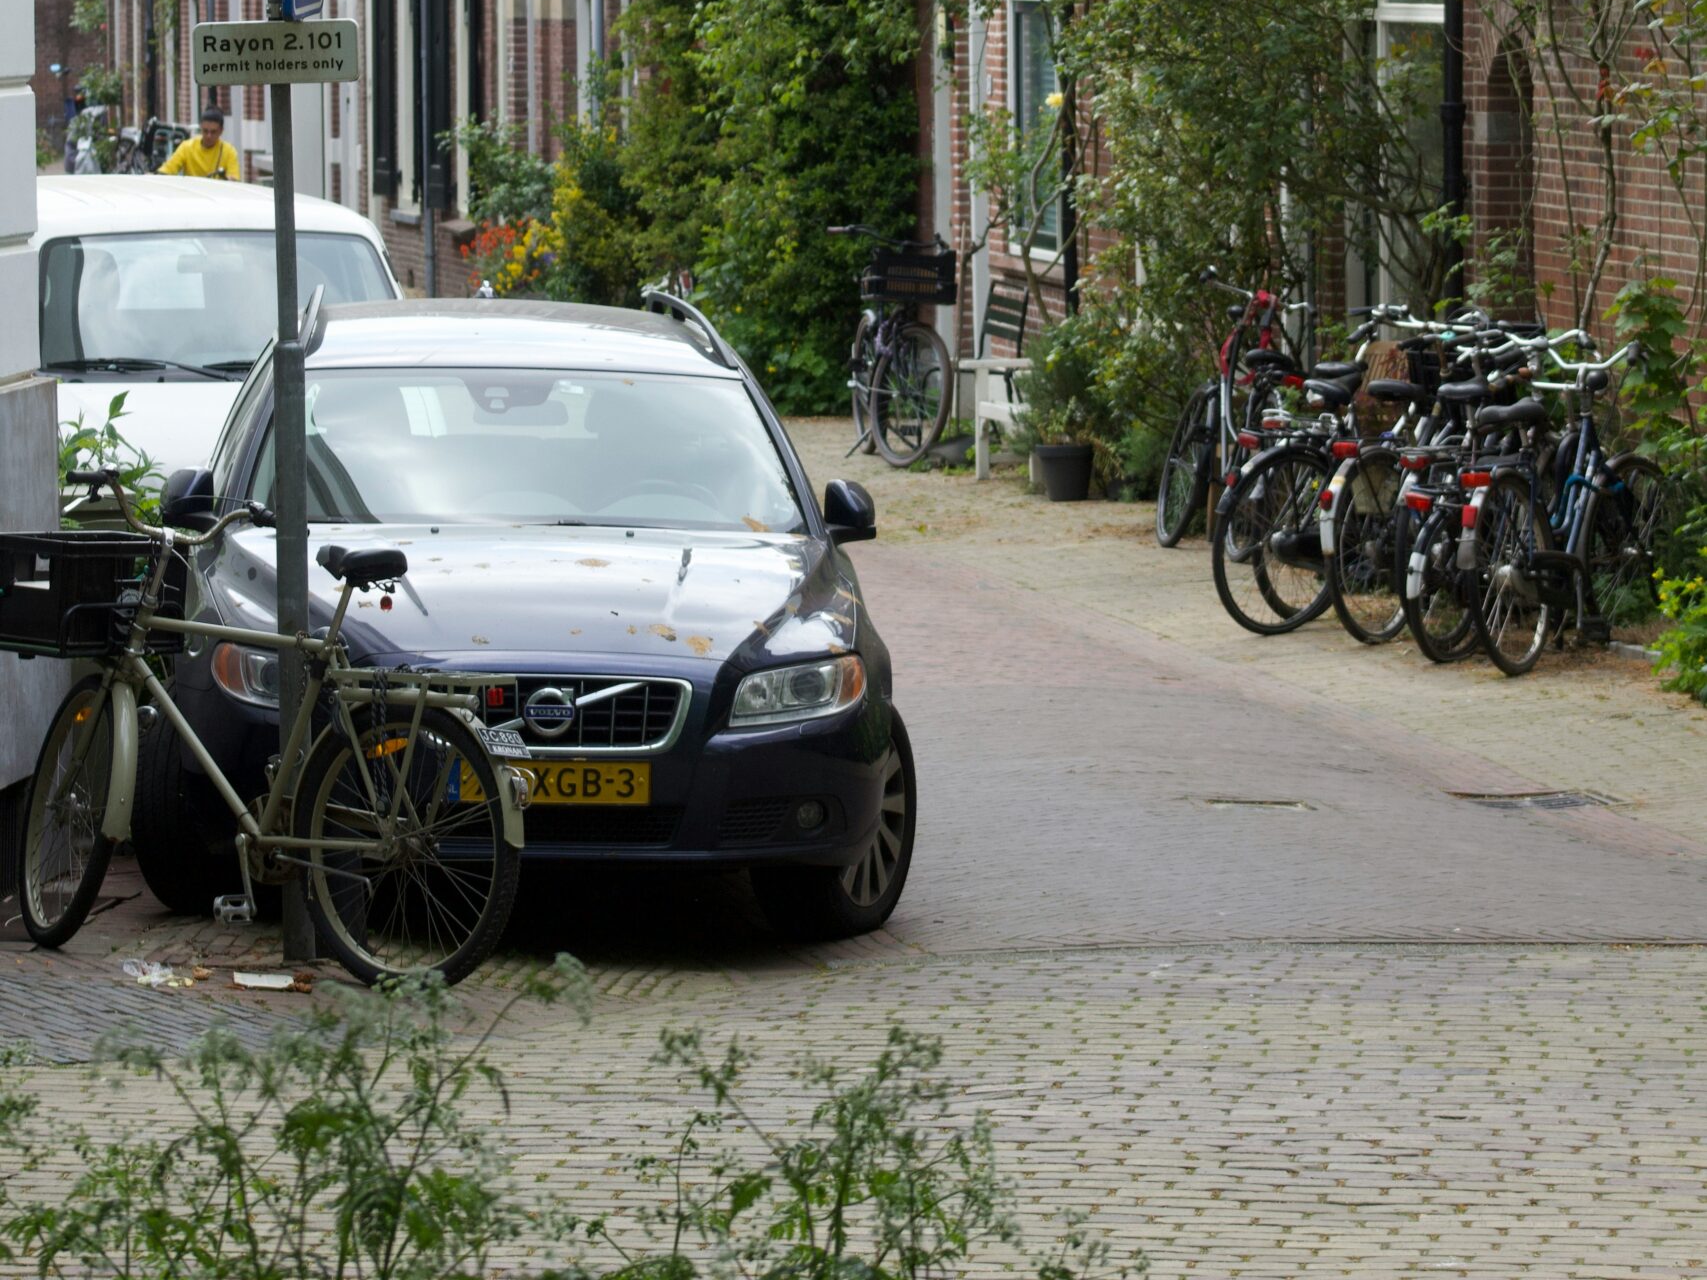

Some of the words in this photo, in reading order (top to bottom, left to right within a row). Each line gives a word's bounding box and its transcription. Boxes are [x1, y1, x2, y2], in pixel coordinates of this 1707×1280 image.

[203, 35, 274, 56] Rayon
[283, 31, 342, 50] 2.101
[203, 60, 250, 74] permit
[255, 58, 308, 71] holders
[313, 57, 344, 72] only
[529, 708, 571, 716] VOLVO
